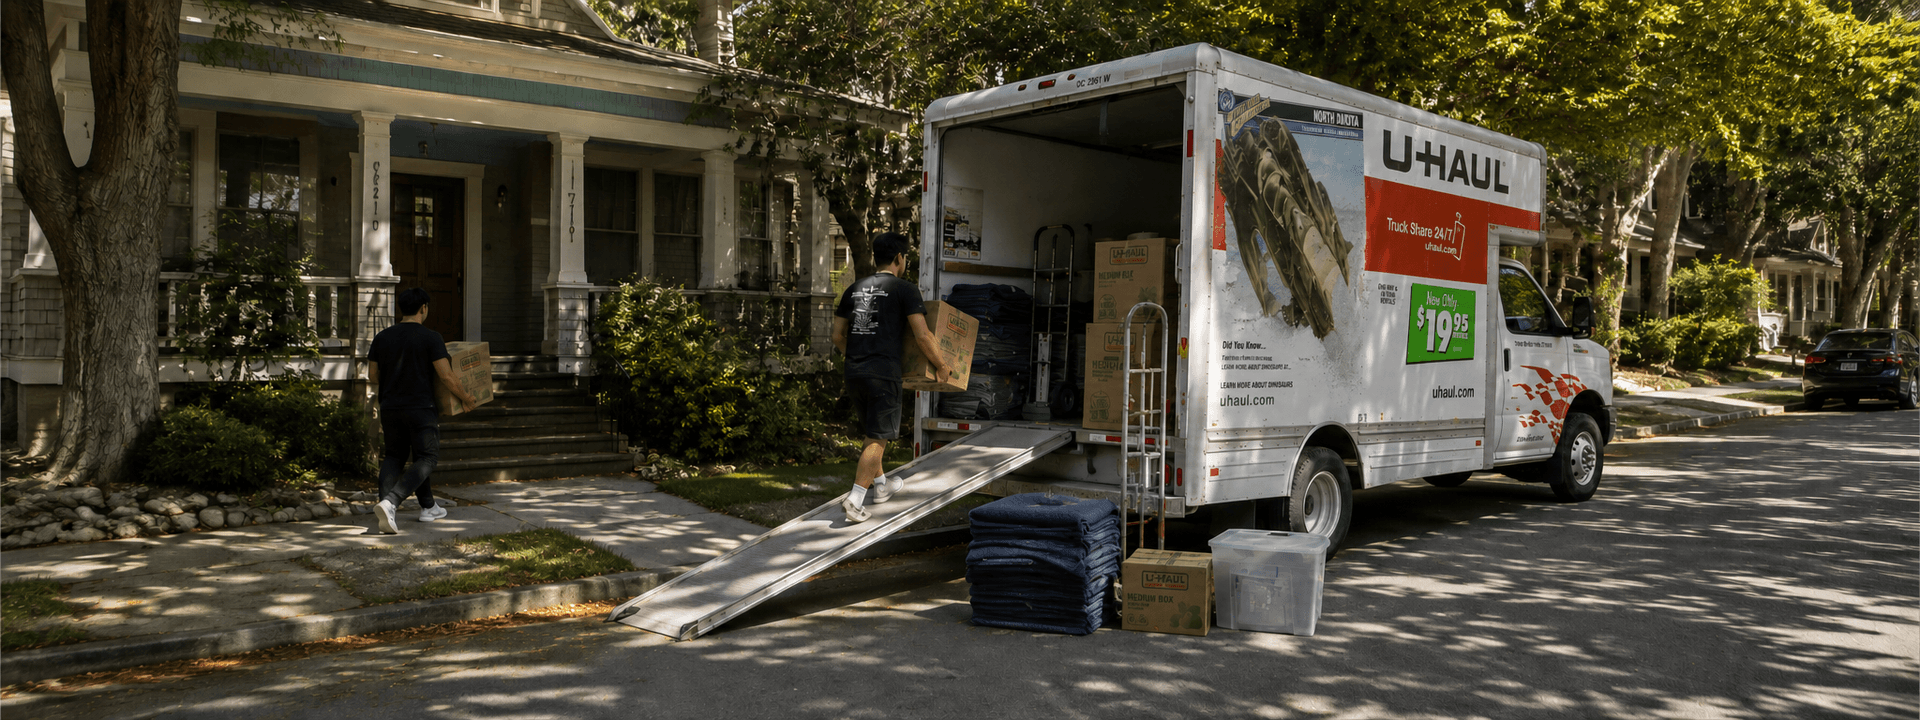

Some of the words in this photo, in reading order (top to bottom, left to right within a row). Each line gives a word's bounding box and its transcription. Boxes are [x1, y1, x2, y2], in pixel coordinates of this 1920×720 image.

[1103, 73, 1111, 83] W
[1313, 109, 1335, 124] NORTH
[1383, 129, 1509, 194] U-HAUL
[1386, 217, 1408, 234] Truck
[1410, 222, 1433, 238] Share
[1434, 226, 1453, 241] 24/7
[1425, 241, 1457, 255] uhaul.com
[1222, 340, 1233, 350] Did
[1251, 381, 1267, 389] ABOUT
[1432, 385, 1475, 399] uhaul.com
[1220, 394, 1274, 407] uhaul.com
[1145, 573, 1186, 584] U-HAUL
[1127, 593, 1156, 602] MEDIUM
[1158, 595, 1174, 604] BOX
